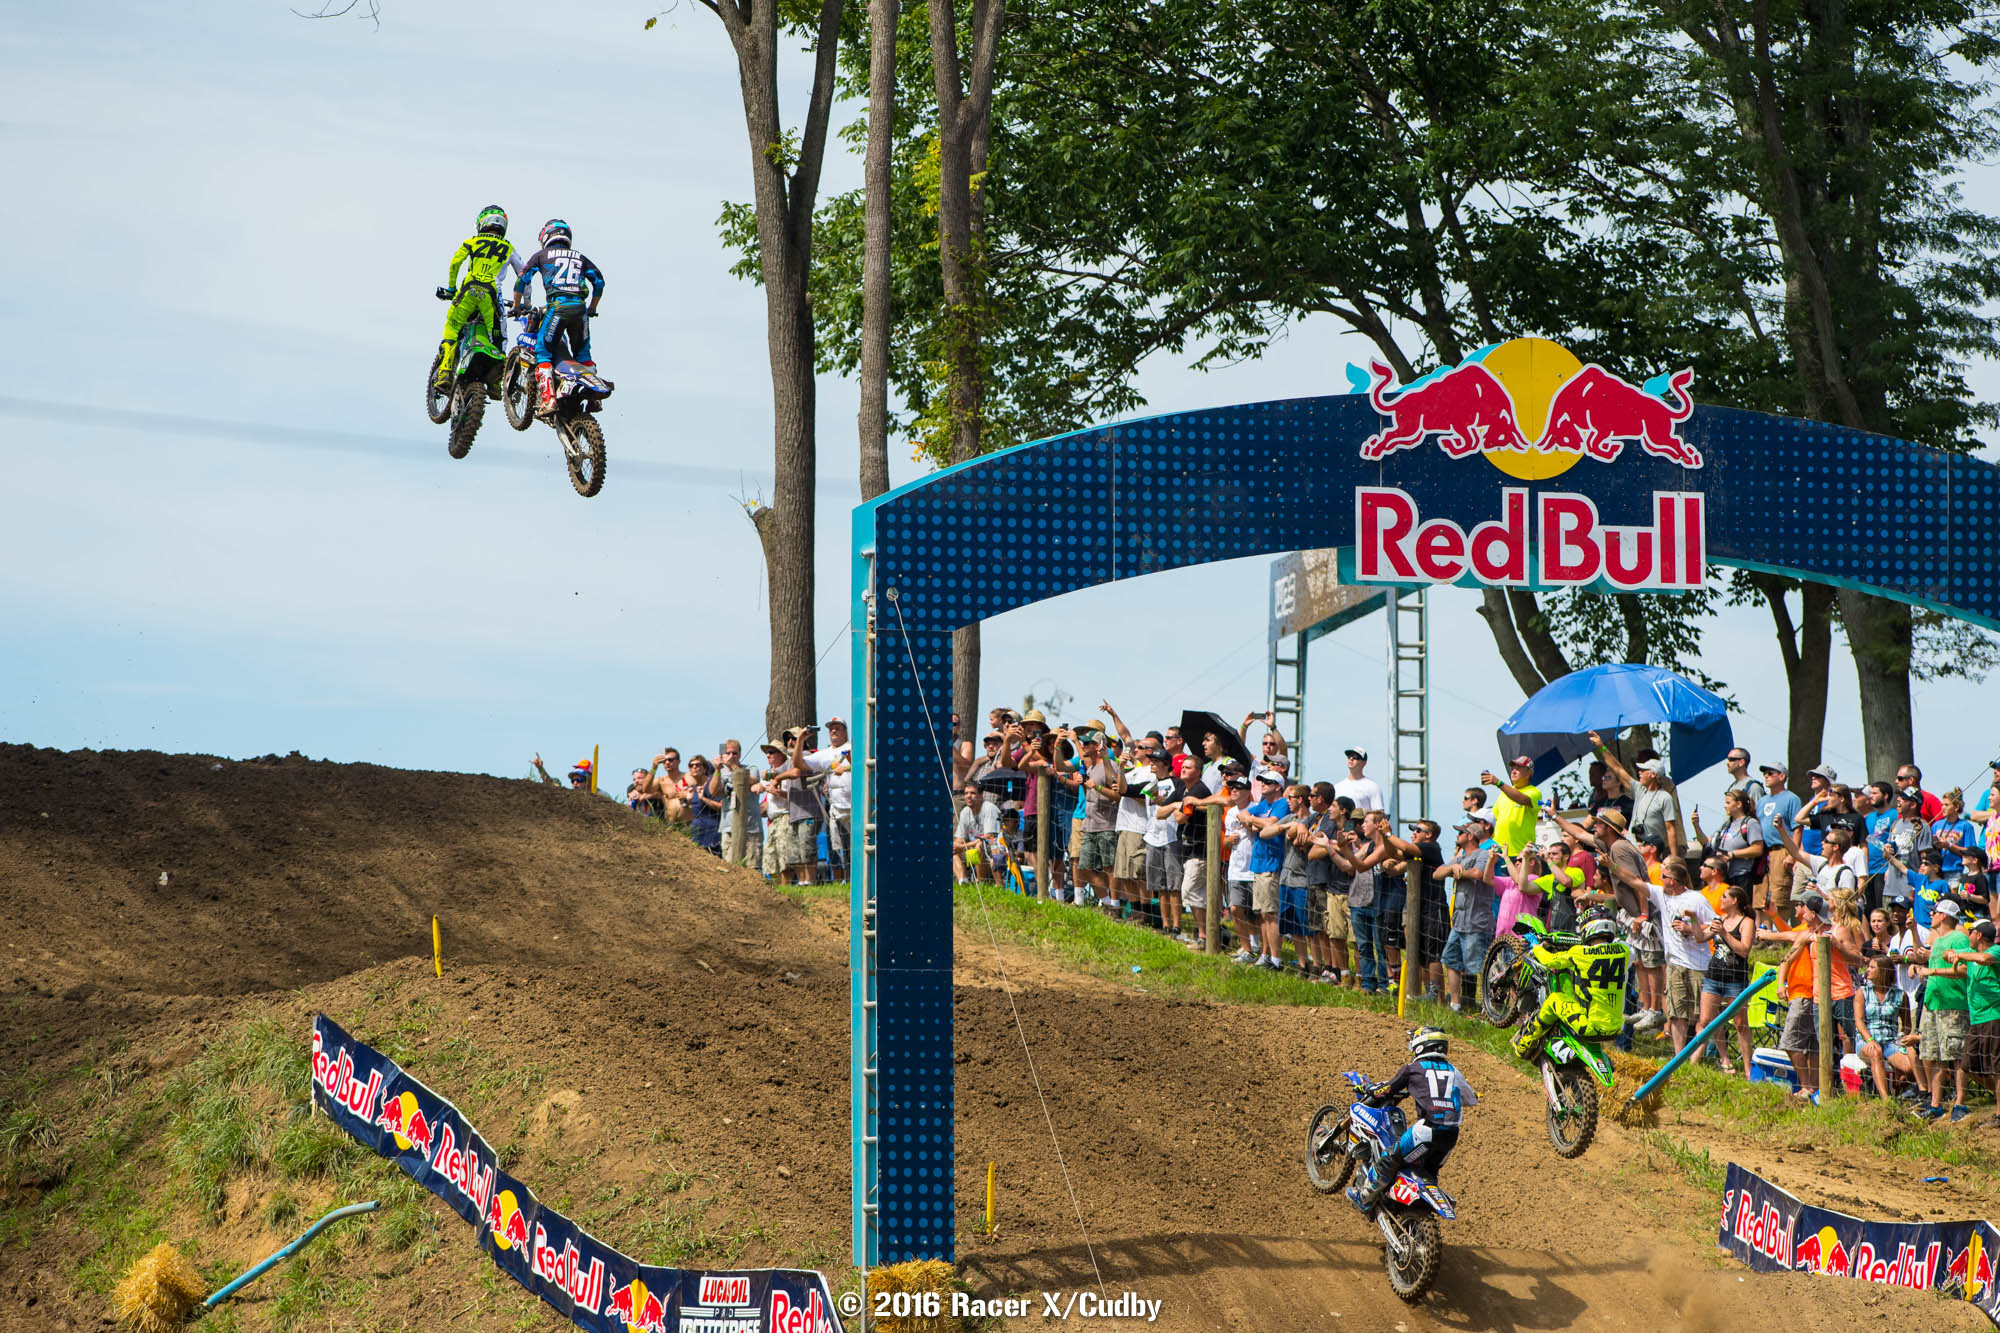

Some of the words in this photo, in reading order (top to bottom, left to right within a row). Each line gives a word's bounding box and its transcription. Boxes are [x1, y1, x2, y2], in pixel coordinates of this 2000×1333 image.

[473, 239, 509, 263] 214
[552, 257, 582, 285] 26
[1357, 488, 1528, 585] Red
[1539, 492, 1704, 589] Bull
[1587, 957, 1626, 989] 44
[1551, 1040, 1571, 1064] 44
[312, 1031, 346, 1098] Red
[336, 1054, 383, 1124] Bull
[1425, 1069, 1455, 1098] 17
[1358, 1108, 1379, 1128] YAMAHA
[432, 1122, 469, 1195] Red
[1735, 1189, 1771, 1251] Red
[1764, 1207, 1795, 1270] Bull
[532, 1222, 571, 1294] Red
[567, 1244, 605, 1315] Bull
[1855, 1242, 1908, 1286] Red
[1901, 1242, 1941, 1291] Bull
[731, 1280, 748, 1303] OIL
[770, 1289, 816, 1333] Red
